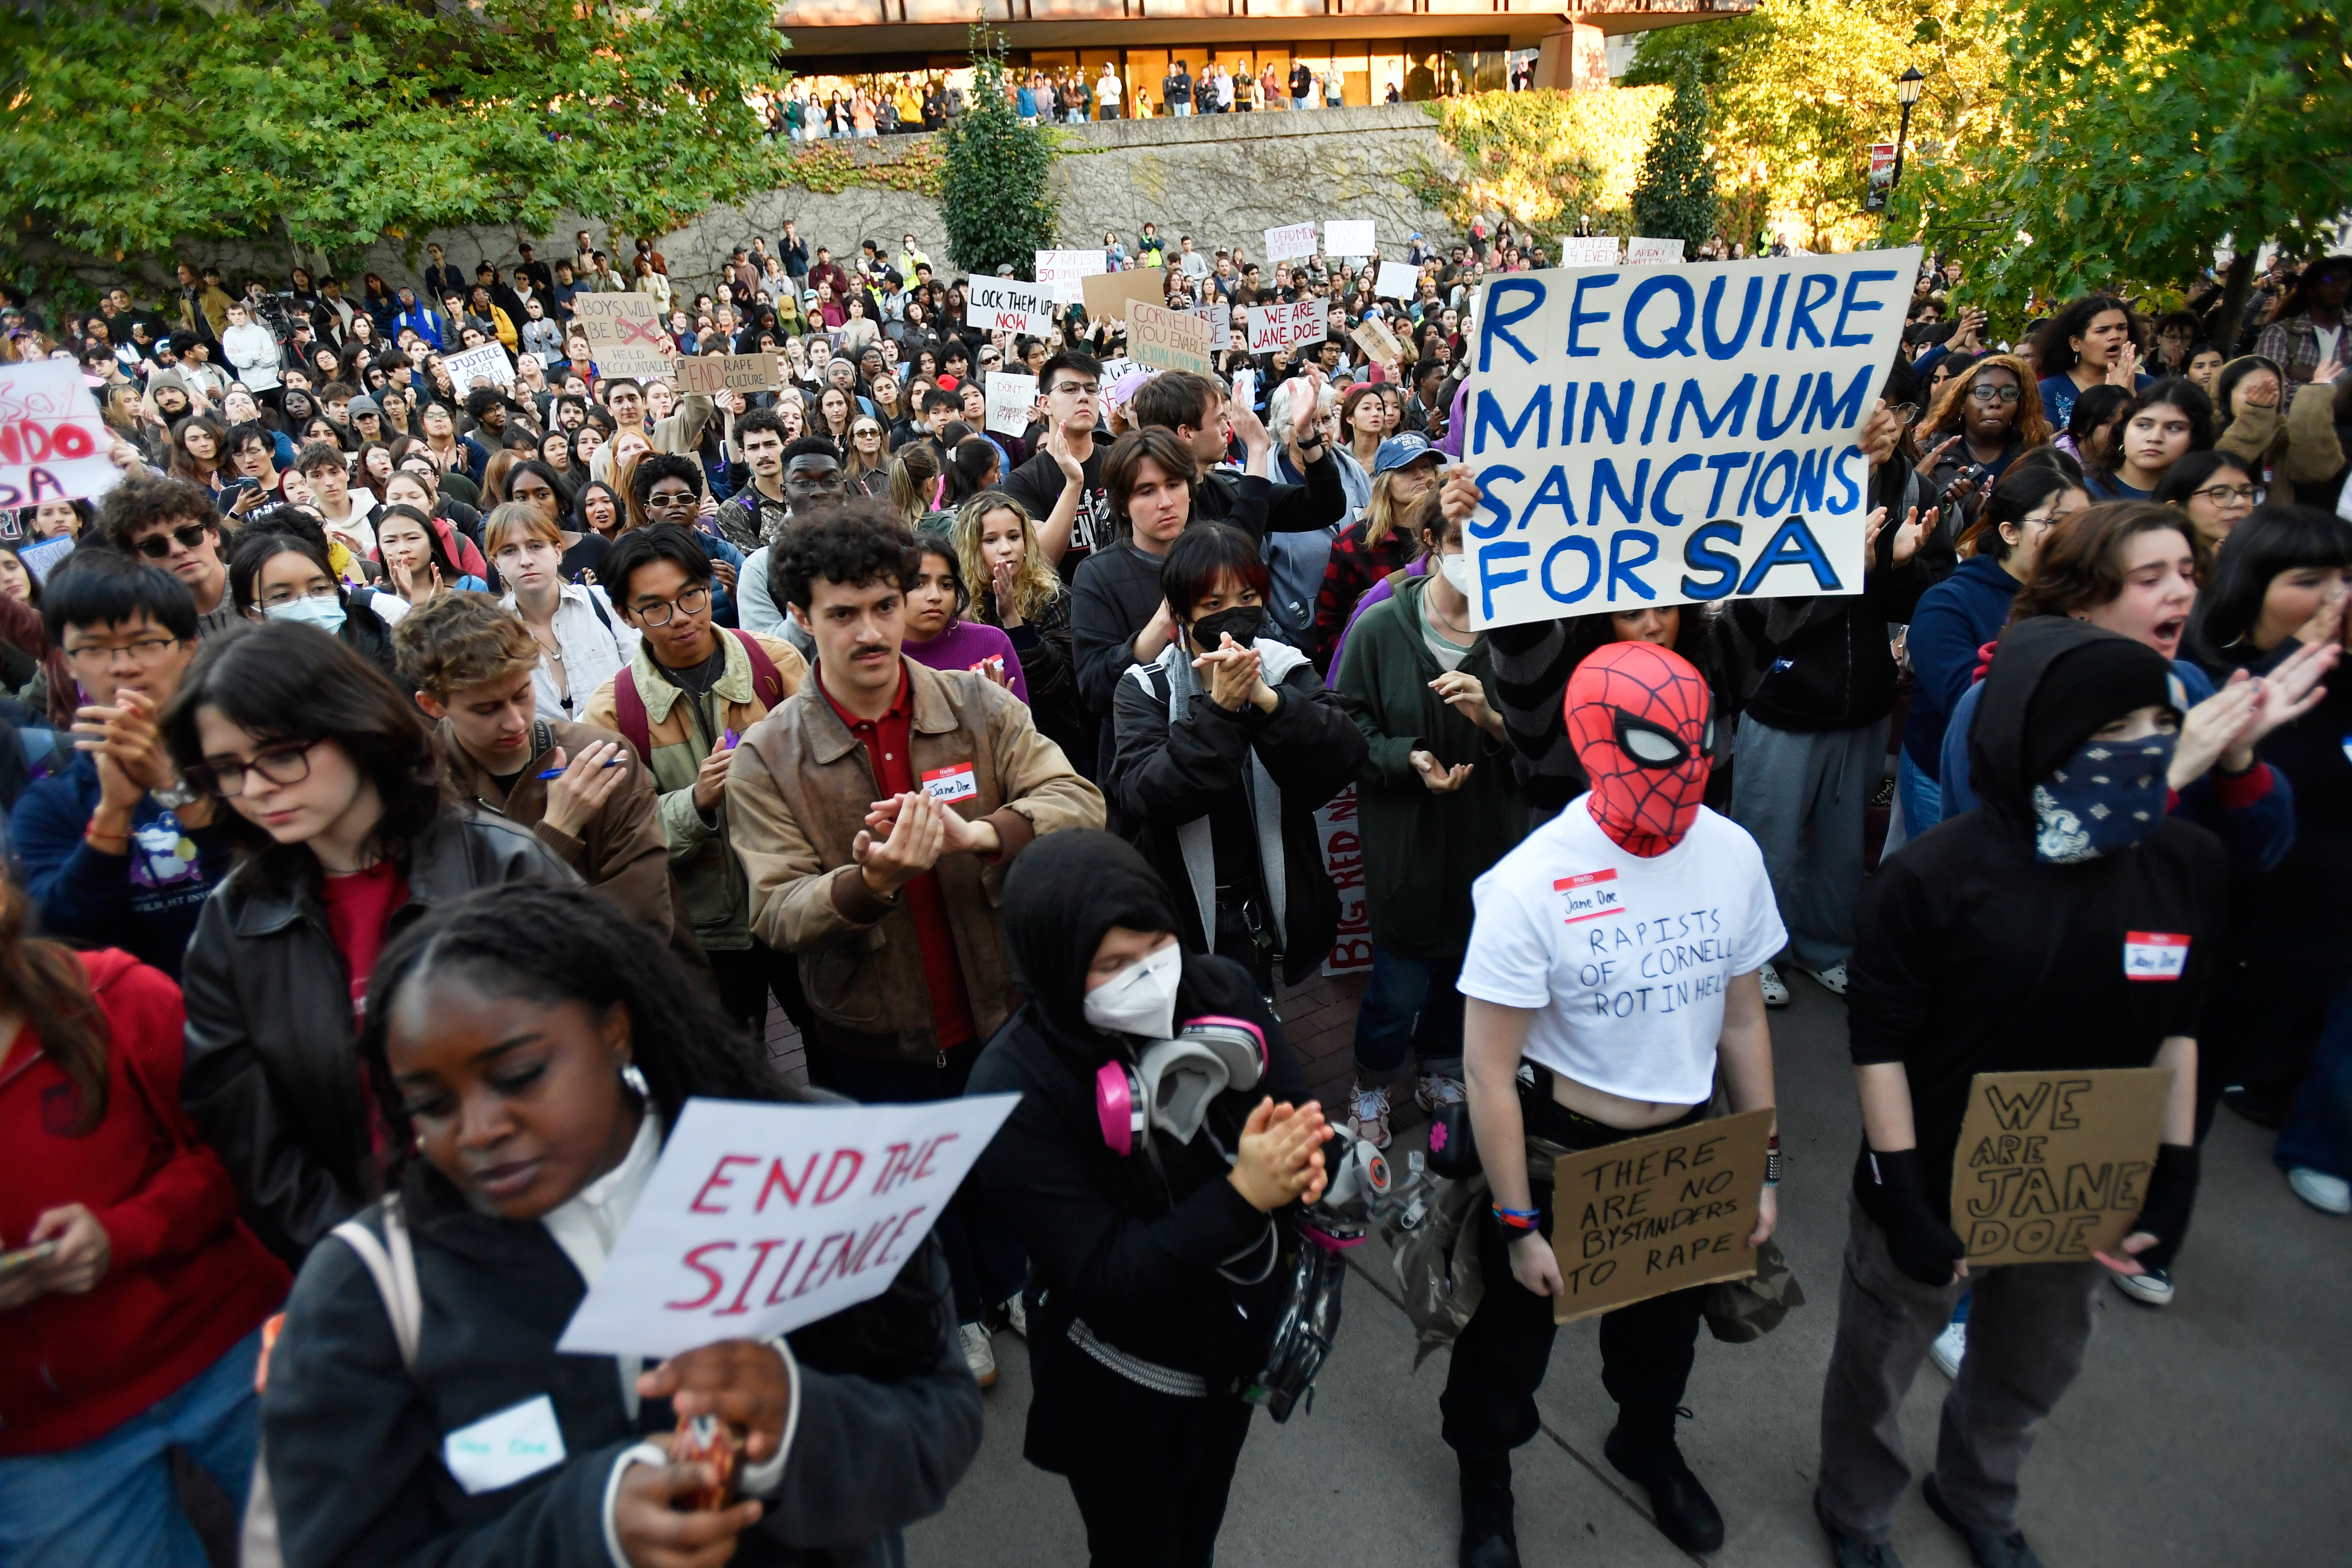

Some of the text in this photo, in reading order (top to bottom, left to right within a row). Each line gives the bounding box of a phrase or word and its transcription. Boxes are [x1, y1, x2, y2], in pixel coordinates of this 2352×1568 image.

[1274, 227, 1316, 243] DEAD MEN
[1569, 238, 1615, 250] JUSTICE
[1044, 253, 1103, 265] 7 RAPISTS
[1571, 249, 1618, 263] 4 EVERY
[1039, 269, 1054, 282] 50
[581, 299, 655, 317] BOYS WILL
[970, 287, 1052, 316] LOCK THEM UP
[1264, 302, 1315, 325] WE ARE
[588, 322, 655, 339] BE BOYS
[996, 312, 1026, 331] NOW
[1253, 319, 1321, 349] JANE DOE
[1478, 270, 1899, 373] REQUIRE
[612, 349, 645, 359] HELD
[1133, 322, 1166, 343] YOU
[1170, 332, 1209, 357] ENABLE
[449, 347, 501, 371] JUSTICE
[467, 361, 494, 378] MUST
[600, 360, 672, 374] ACCOUNTABLE
[1133, 342, 1170, 367] SEXUAL
[1172, 350, 1209, 376] VIOLENCE
[689, 359, 753, 392] END RAPE
[725, 374, 765, 388] CULTURE
[997, 382, 1024, 395] DONT
[997, 411, 1027, 425] RAPIST
[1473, 364, 1875, 455] MINIMUM
[1392, 435, 1412, 445] STILL
[1468, 444, 1862, 539] SANCTIONS
[1478, 515, 1844, 621] FOR SA
[928, 780, 971, 797] Jane Doe
[1327, 830, 1365, 890] RED
[1574, 874, 1594, 884] Hello
[1562, 890, 1618, 915] Jane Doe
[1329, 900, 1374, 969] BIG
[1590, 909, 1720, 956] RAPISTS
[1581, 938, 1732, 987] OF CORNELL
[1596, 987, 1654, 1018] ROT
[1661, 981, 1688, 1013] IN
[1985, 1080, 2092, 1130] WE
[1582, 1136, 1727, 1192] THERE
[1969, 1135, 2048, 1167] ARE
[687, 1133, 959, 1215] END THE
[1580, 1171, 1734, 1230] ARE NO
[1968, 1162, 2152, 1218] JANE
[1583, 1199, 1737, 1259] BYSTANDERS
[1965, 1214, 2101, 1256] DOE
[1568, 1233, 1733, 1295] TO RAPE
